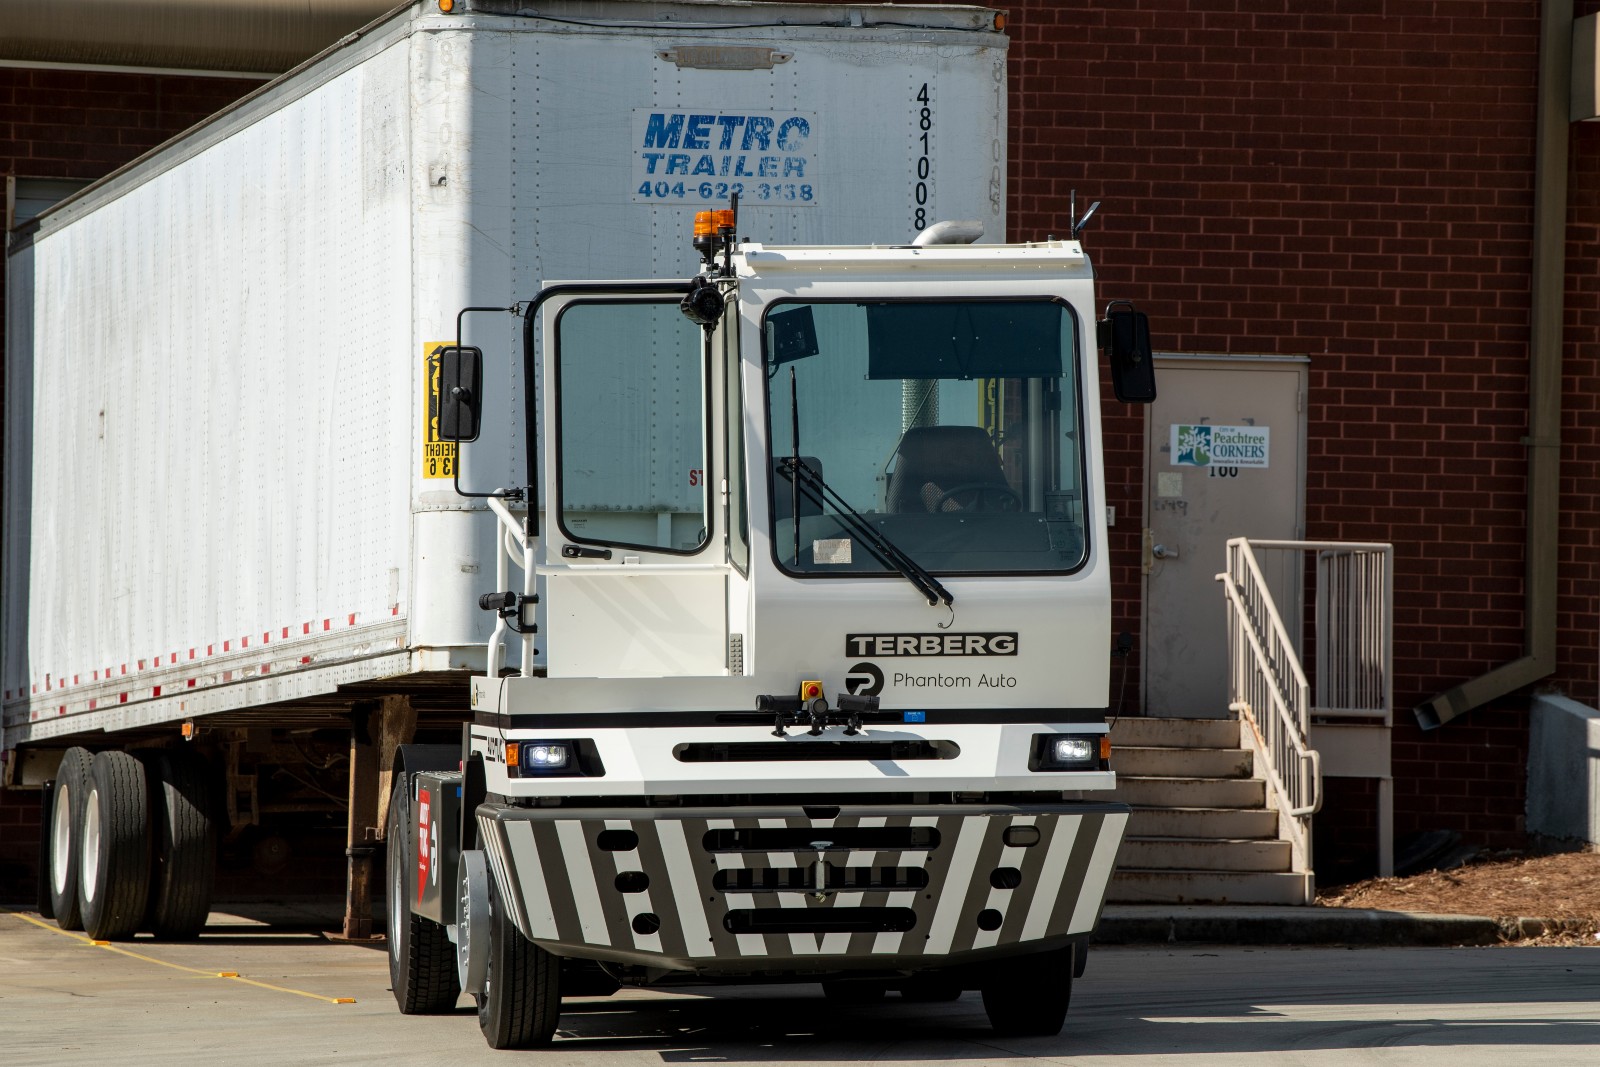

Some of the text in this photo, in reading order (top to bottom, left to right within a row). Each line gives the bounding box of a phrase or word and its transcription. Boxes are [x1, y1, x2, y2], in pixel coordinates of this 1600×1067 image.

[643, 113, 810, 151] METRO
[642, 152, 807, 178] TRAILER
[914, 82, 932, 231] 481008
[1214, 432, 1265, 444] Peachtree
[1213, 444, 1265, 458] CORNERS
[850, 635, 1015, 655] TERBERG
[893, 673, 1017, 688] Phantom Auto
